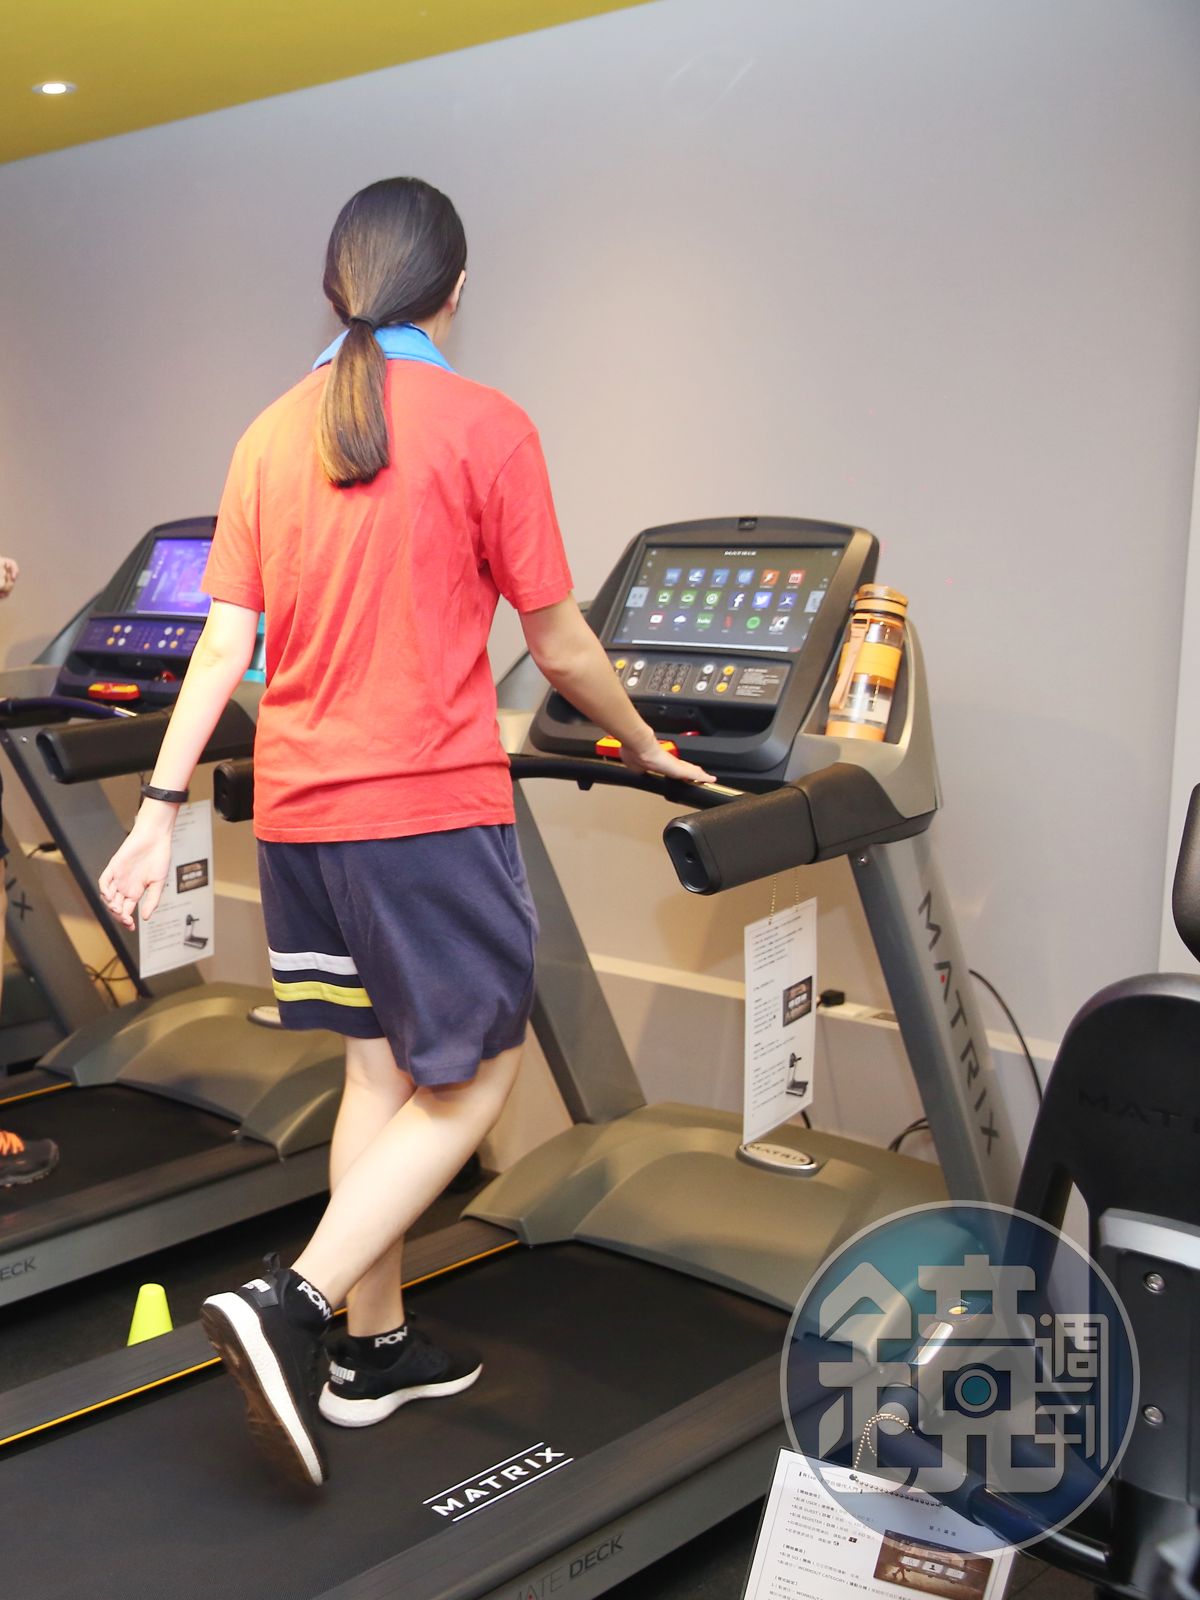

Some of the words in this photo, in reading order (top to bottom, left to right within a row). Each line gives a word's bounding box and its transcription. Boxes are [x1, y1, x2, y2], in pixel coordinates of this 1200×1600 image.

[917, 890, 1000, 1156] MATRIX
[374, 1326, 408, 1348] PON
[431, 1447, 565, 1516] MATRIX
[569, 1534, 624, 1578] DECK
